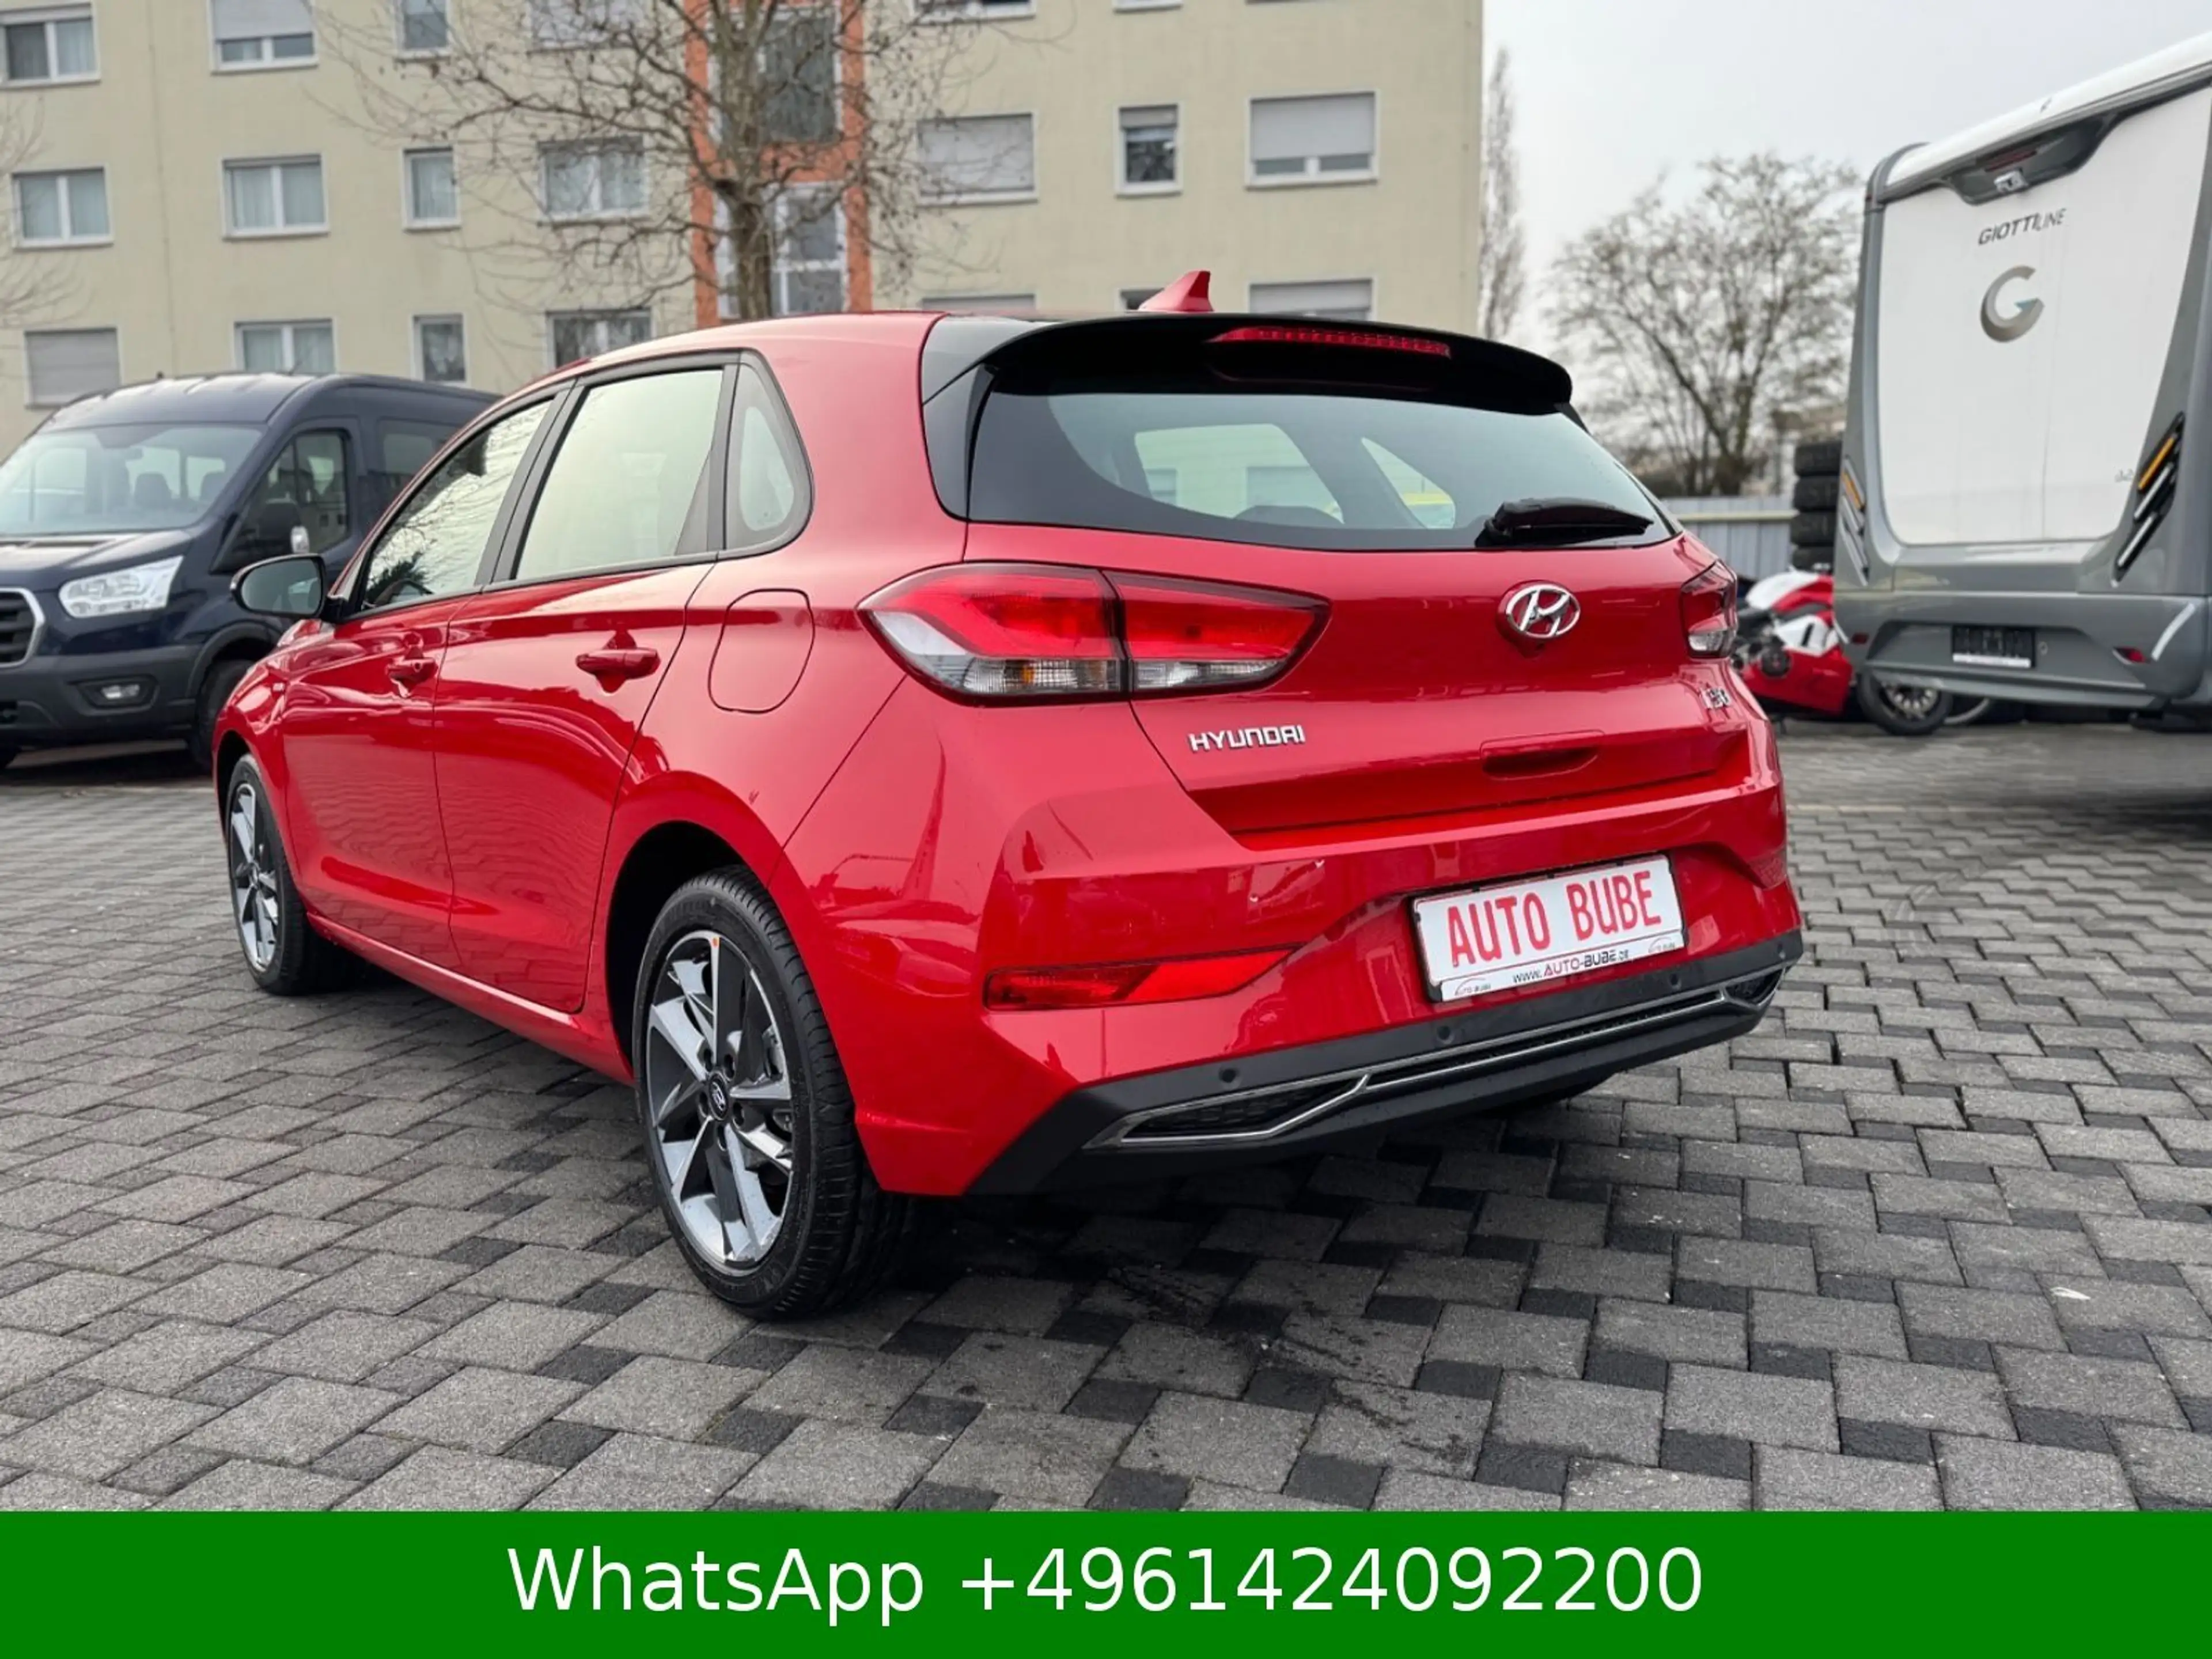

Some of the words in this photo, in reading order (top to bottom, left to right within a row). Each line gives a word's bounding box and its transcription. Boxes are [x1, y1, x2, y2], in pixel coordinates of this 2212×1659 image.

[1188, 724, 1306, 752] HYUNDAI
[1448, 892, 1551, 967] AUTO
[1566, 870, 1661, 942] BUBE
